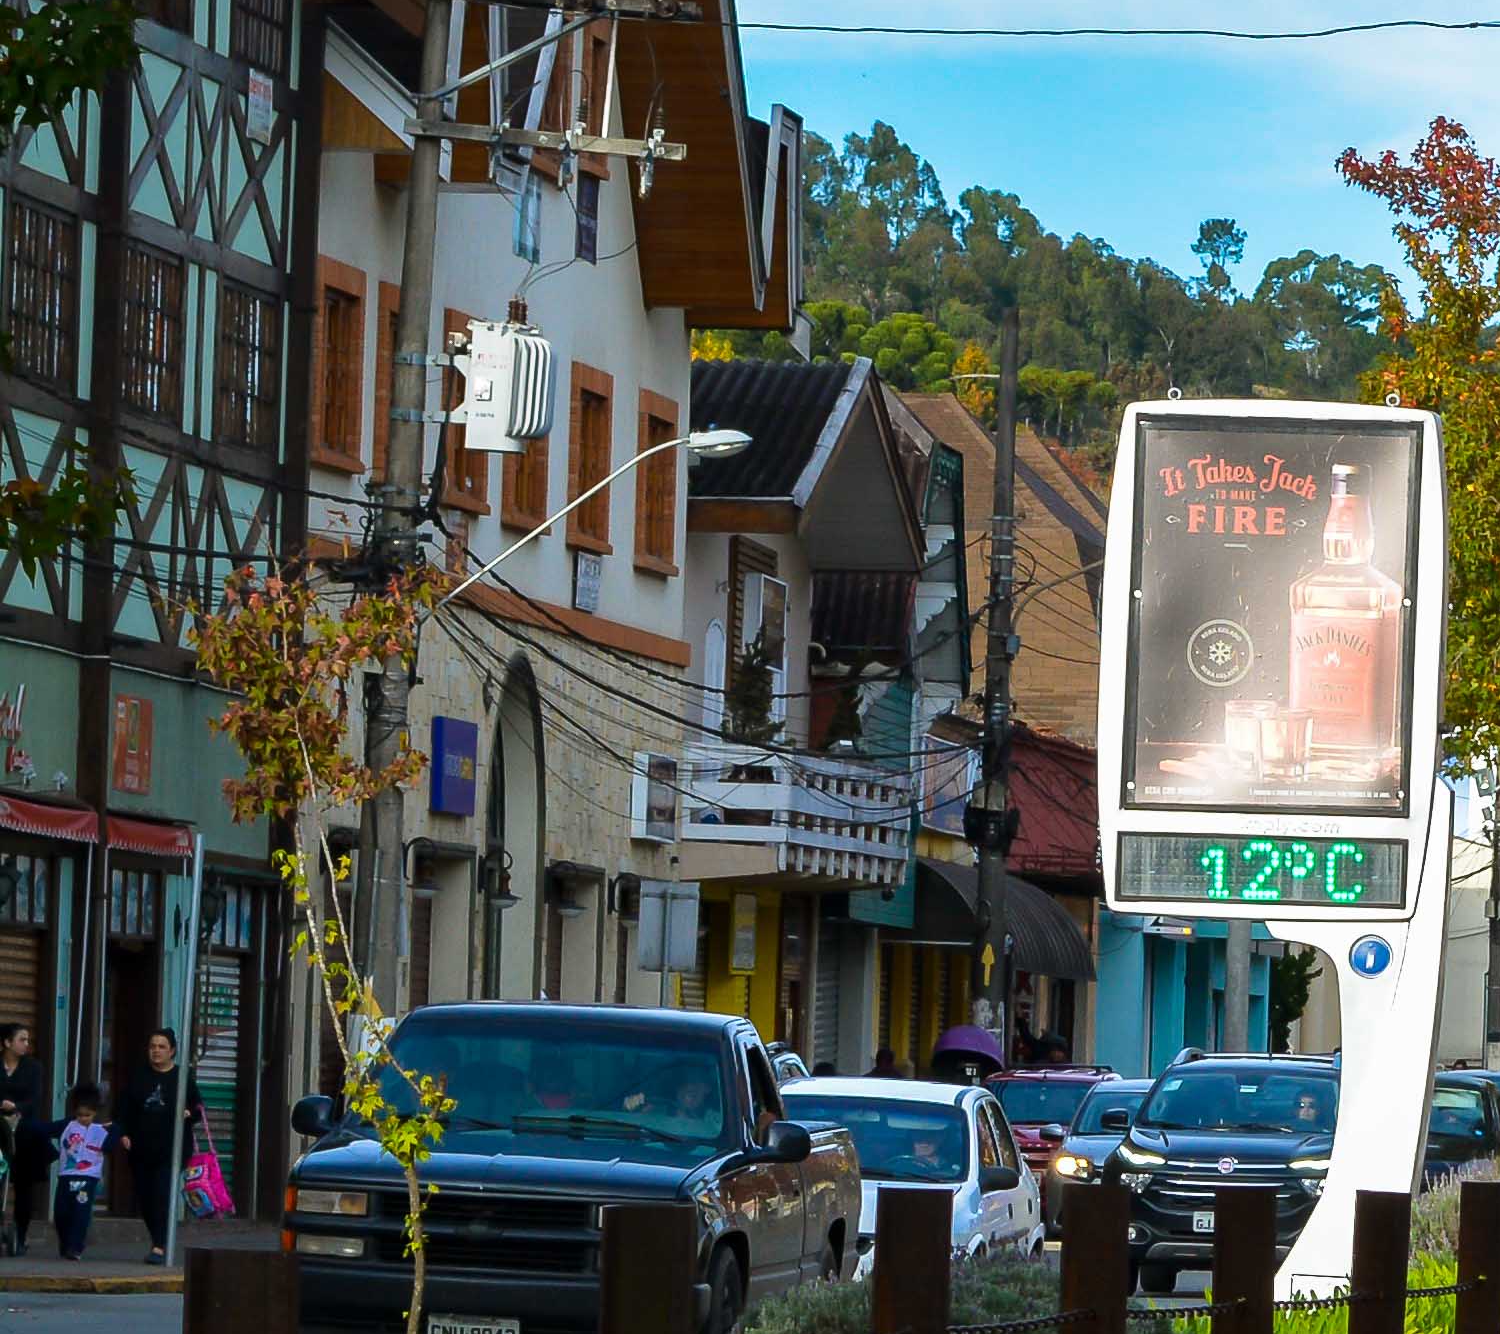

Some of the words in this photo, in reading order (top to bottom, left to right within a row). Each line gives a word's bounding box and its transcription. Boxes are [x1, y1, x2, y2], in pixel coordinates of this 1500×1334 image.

[1159, 466, 1186, 497] It
[1187, 453, 1257, 490] Takes
[1259, 453, 1318, 501] Jack
[1186, 502, 1288, 537] FIRE
